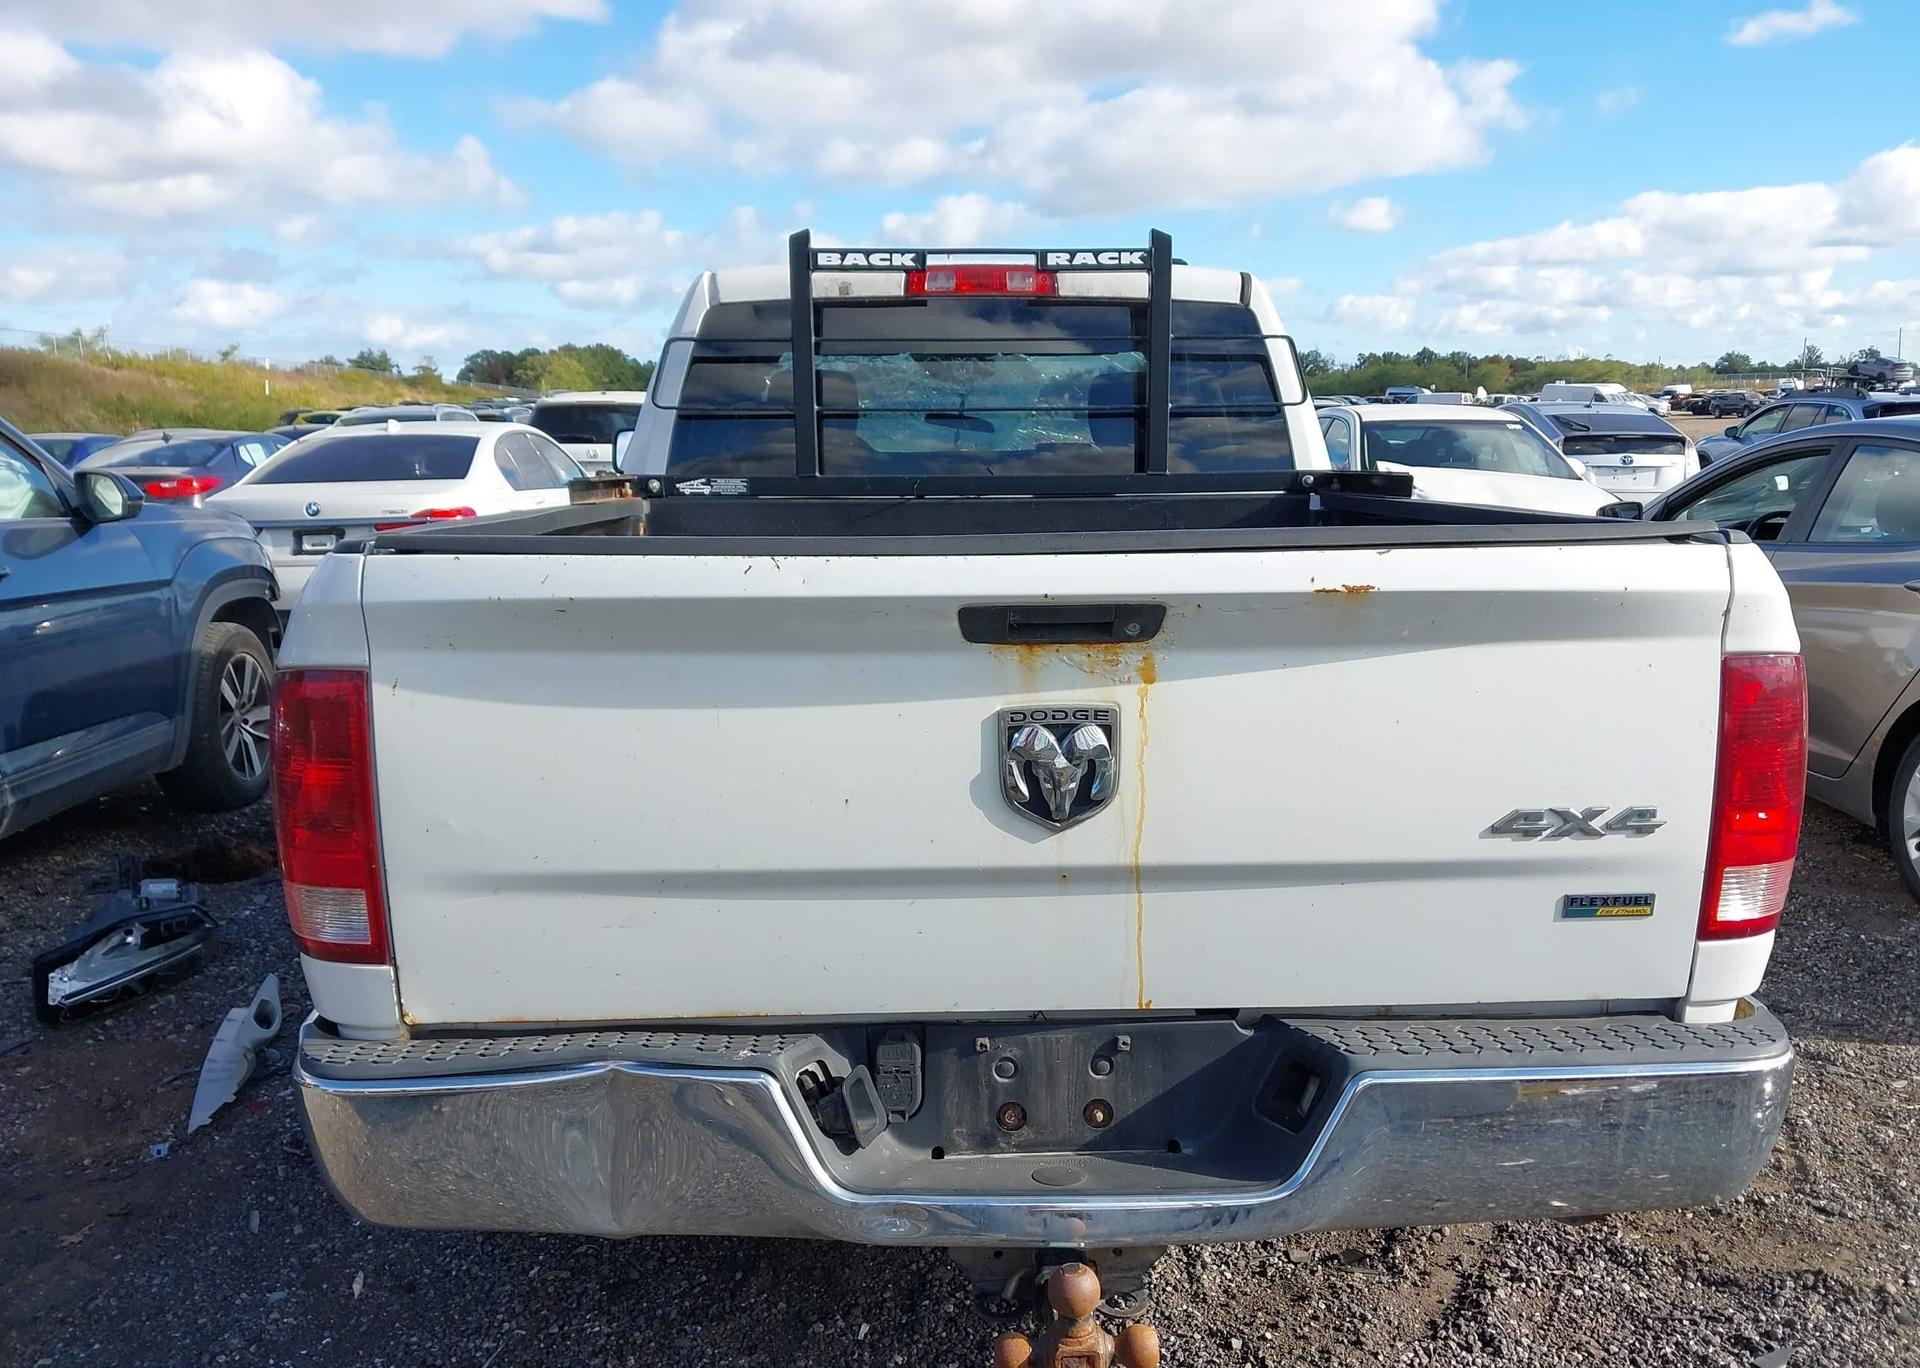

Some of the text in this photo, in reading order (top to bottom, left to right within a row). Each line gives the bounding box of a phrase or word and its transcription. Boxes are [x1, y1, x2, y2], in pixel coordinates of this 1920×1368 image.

[817, 251, 1145, 266] BACK RACK
[1009, 709, 1110, 723] DODGE
[1569, 895, 1653, 907] FLEXFUEL
